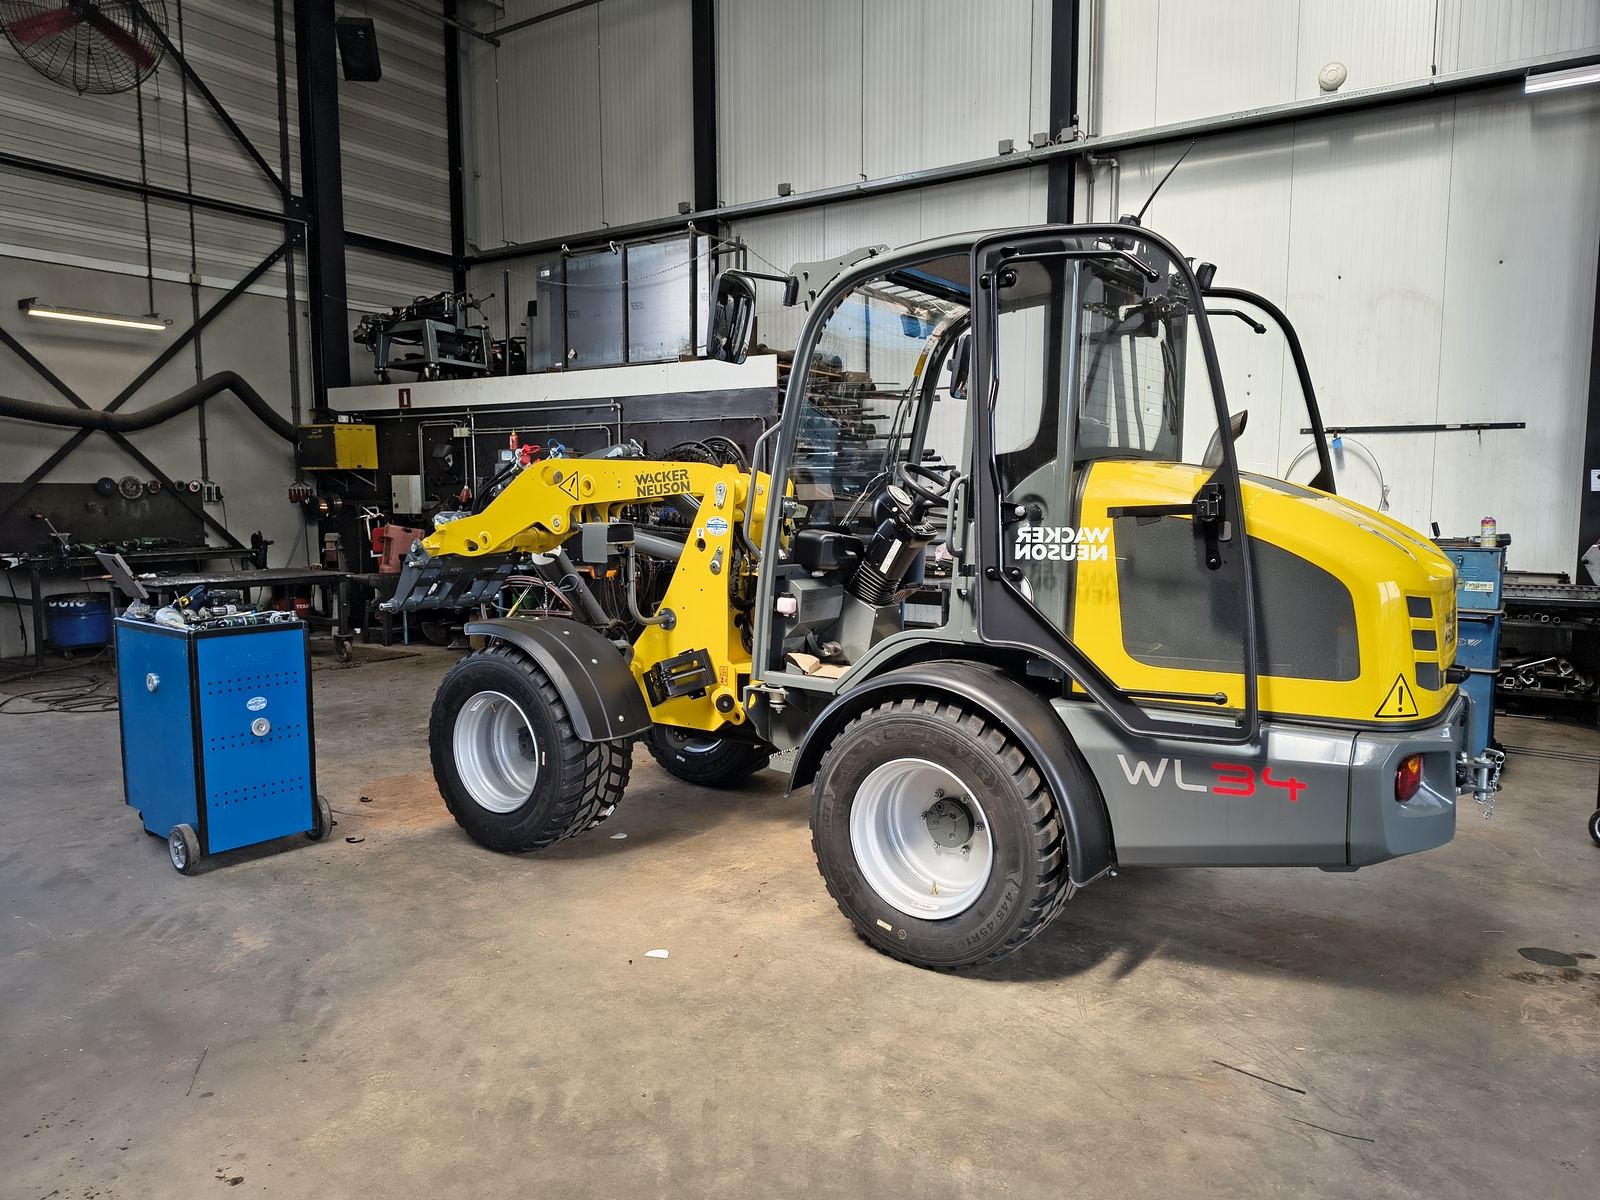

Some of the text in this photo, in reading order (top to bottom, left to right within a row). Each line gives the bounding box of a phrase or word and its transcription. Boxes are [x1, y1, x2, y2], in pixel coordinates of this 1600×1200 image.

[634, 468, 690, 486] WACKER
[636, 480, 691, 497] NEUSON
[1116, 753, 1307, 802] WL34
